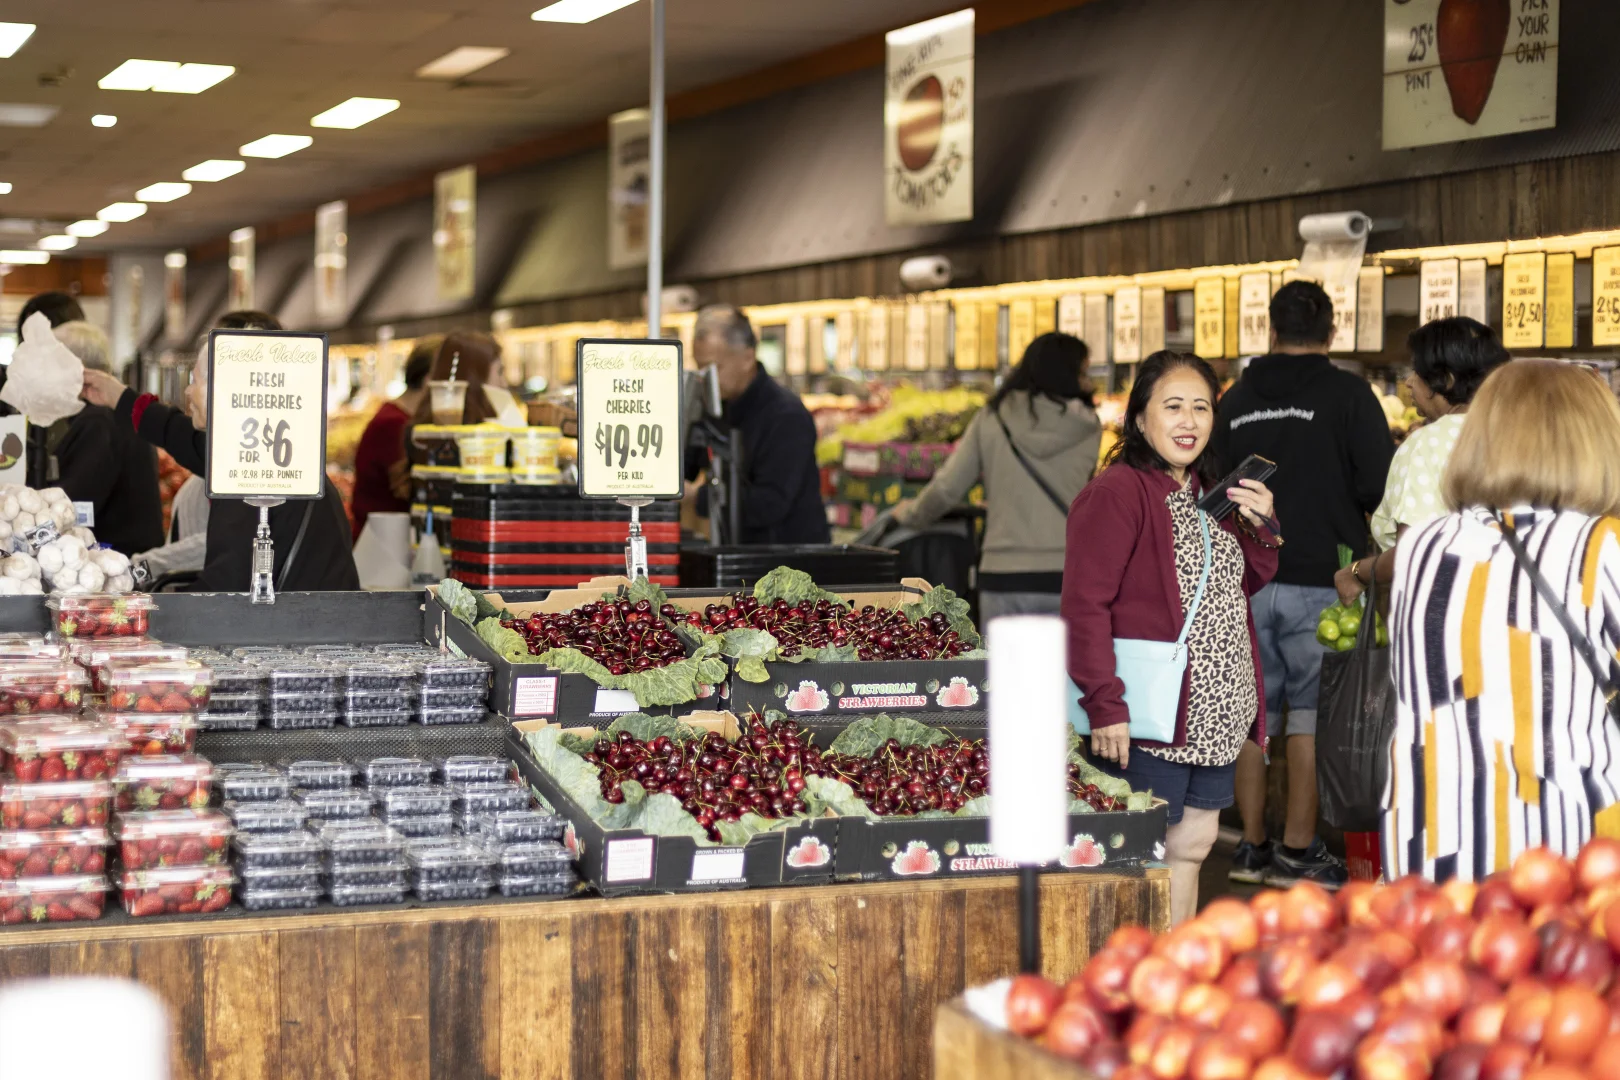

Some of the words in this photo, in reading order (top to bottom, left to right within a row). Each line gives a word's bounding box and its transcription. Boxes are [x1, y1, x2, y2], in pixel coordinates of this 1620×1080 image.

[1517, 13, 1549, 37] YOUR
[1516, 41, 1547, 63] OWN
[1405, 71, 1431, 92] PINT
[216, 341, 263, 365] Fresh
[269, 342, 317, 364] Value
[583, 350, 625, 373] Fresh
[629, 351, 672, 371] Value
[249, 372, 285, 388] FRESH
[613, 378, 644, 394] FRESH
[231, 393, 302, 410] BLUEBERRIES
[606, 399, 651, 415] CHERRIES
[239, 417, 260, 449] 3
[262, 417, 293, 468] $6
[594, 422, 663, 469] $19.99
[239, 450, 260, 463] FOR
[229, 470, 238, 479] OR
[241, 470, 258, 479] $2.98
[261, 470, 274, 479] PER
[277, 470, 302, 480] PUNNET
[617, 471, 629, 480] PER
[631, 471, 644, 480] KILO
[852, 683, 917, 695] VICTORIAN
[838, 696, 927, 709] STRAWBERRIES
